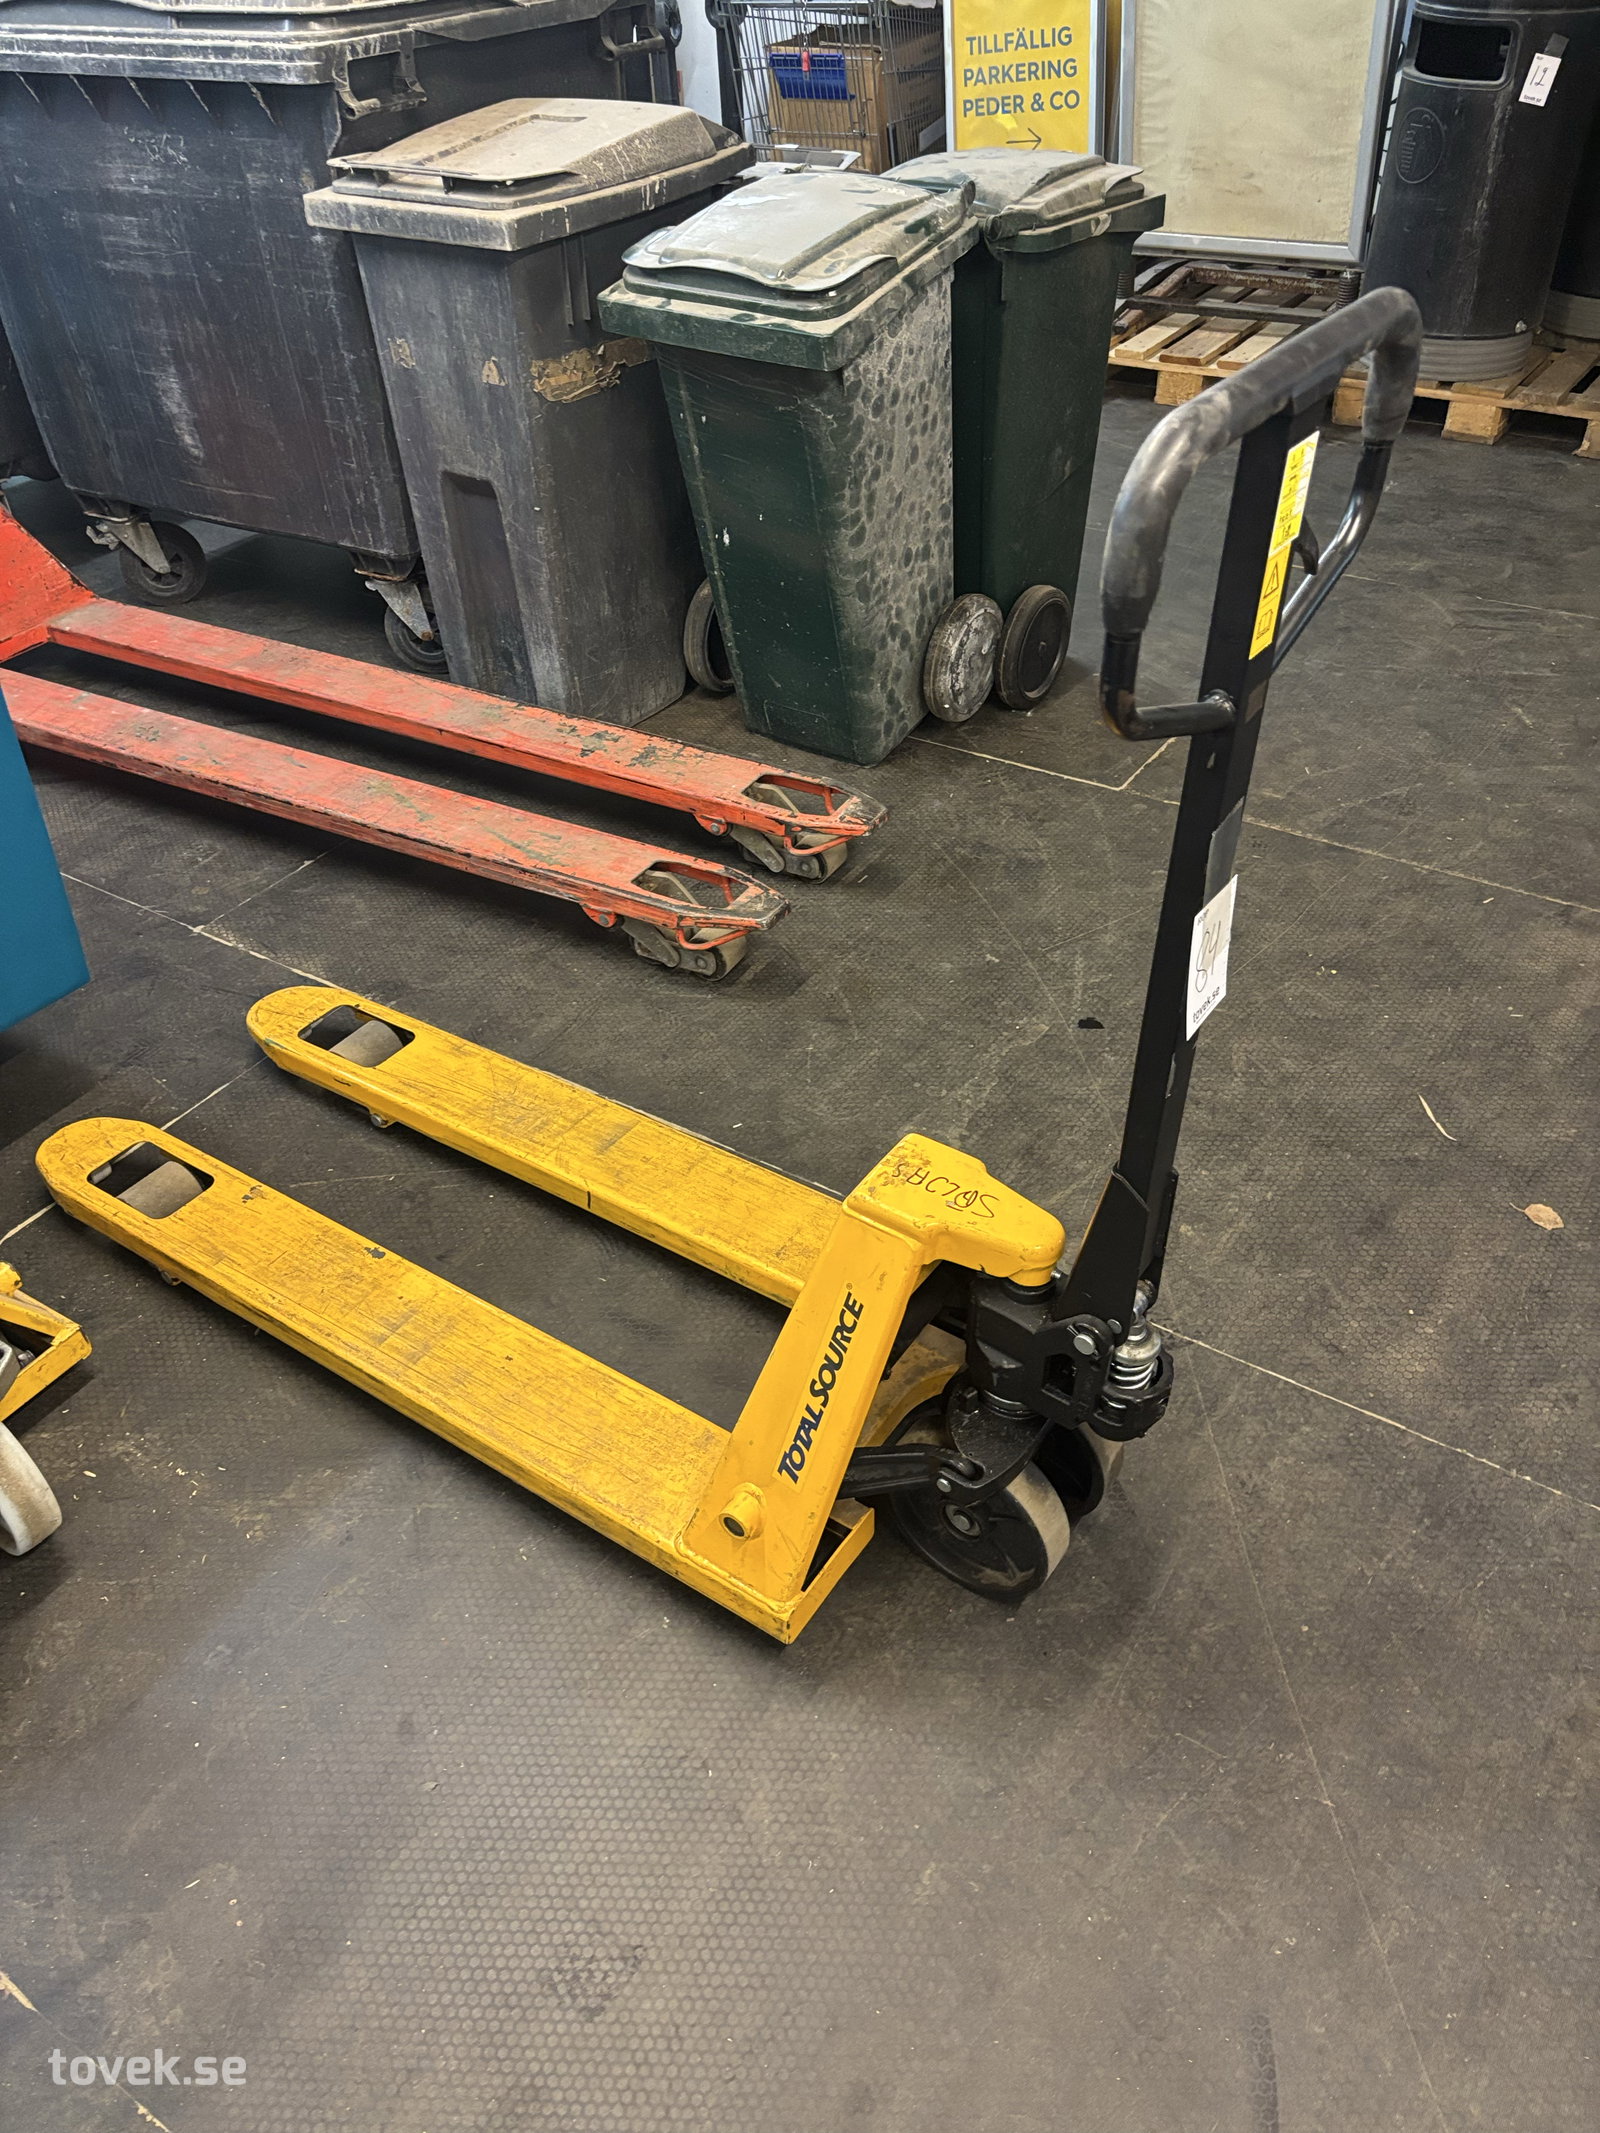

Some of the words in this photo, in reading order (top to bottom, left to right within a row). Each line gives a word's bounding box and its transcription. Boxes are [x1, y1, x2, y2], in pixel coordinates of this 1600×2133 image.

[965, 26, 1073, 56] TILLFÄLLIG
[963, 57, 1078, 88] PARKERING
[962, 94, 1025, 118] PEDER
[1030, 92, 1045, 113] &
[1049, 89, 1081, 110] CO
[1192, 986, 1221, 1024] tovek.se
